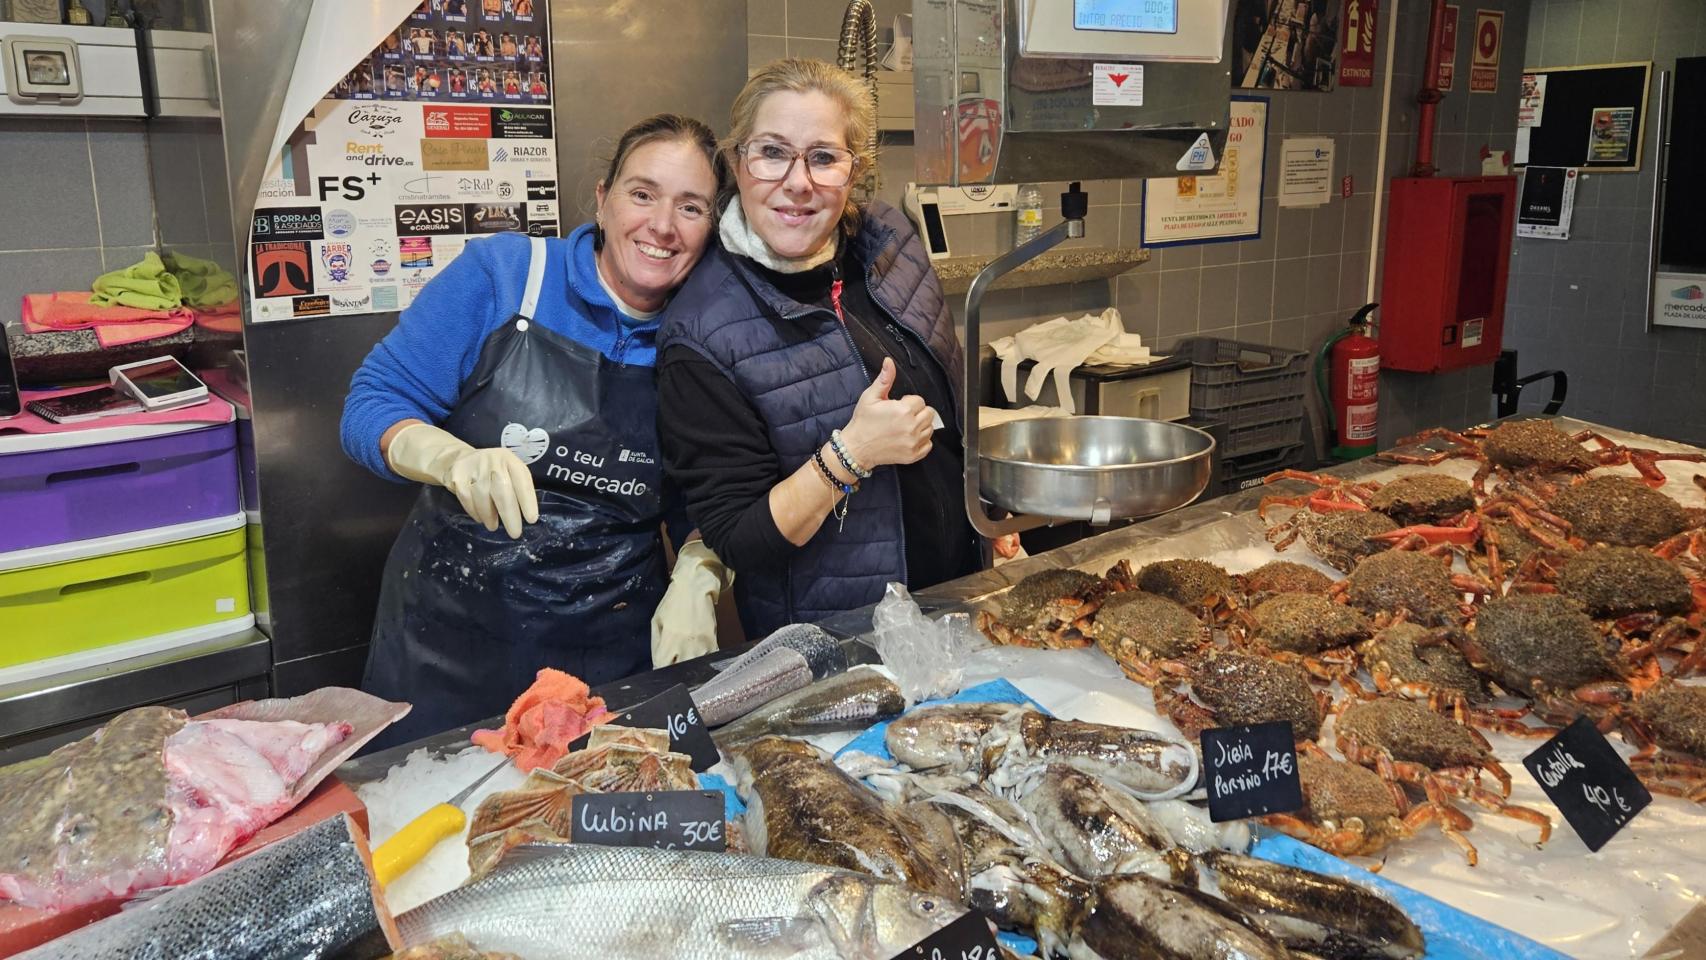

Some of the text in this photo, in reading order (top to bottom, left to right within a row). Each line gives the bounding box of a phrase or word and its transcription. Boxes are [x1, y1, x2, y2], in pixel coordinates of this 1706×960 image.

[403, 38, 412, 51] VS
[467, 42, 475, 54] VS
[348, 109, 403, 126] Cazuza
[346, 142, 384, 154] Rent
[513, 147, 548, 156] RIAZOR
[473, 178, 494, 191] RdP
[500, 187, 511, 196] 59
[273, 214, 321, 223] BORRAJO
[399, 207, 462, 225] OASIS
[415, 223, 446, 231] CORUÑA
[573, 449, 605, 468] teu
[546, 462, 647, 497] mercado
[667, 707, 698, 741] 16€
[1262, 749, 1293, 782] 17€
[679, 820, 722, 846] 30€
